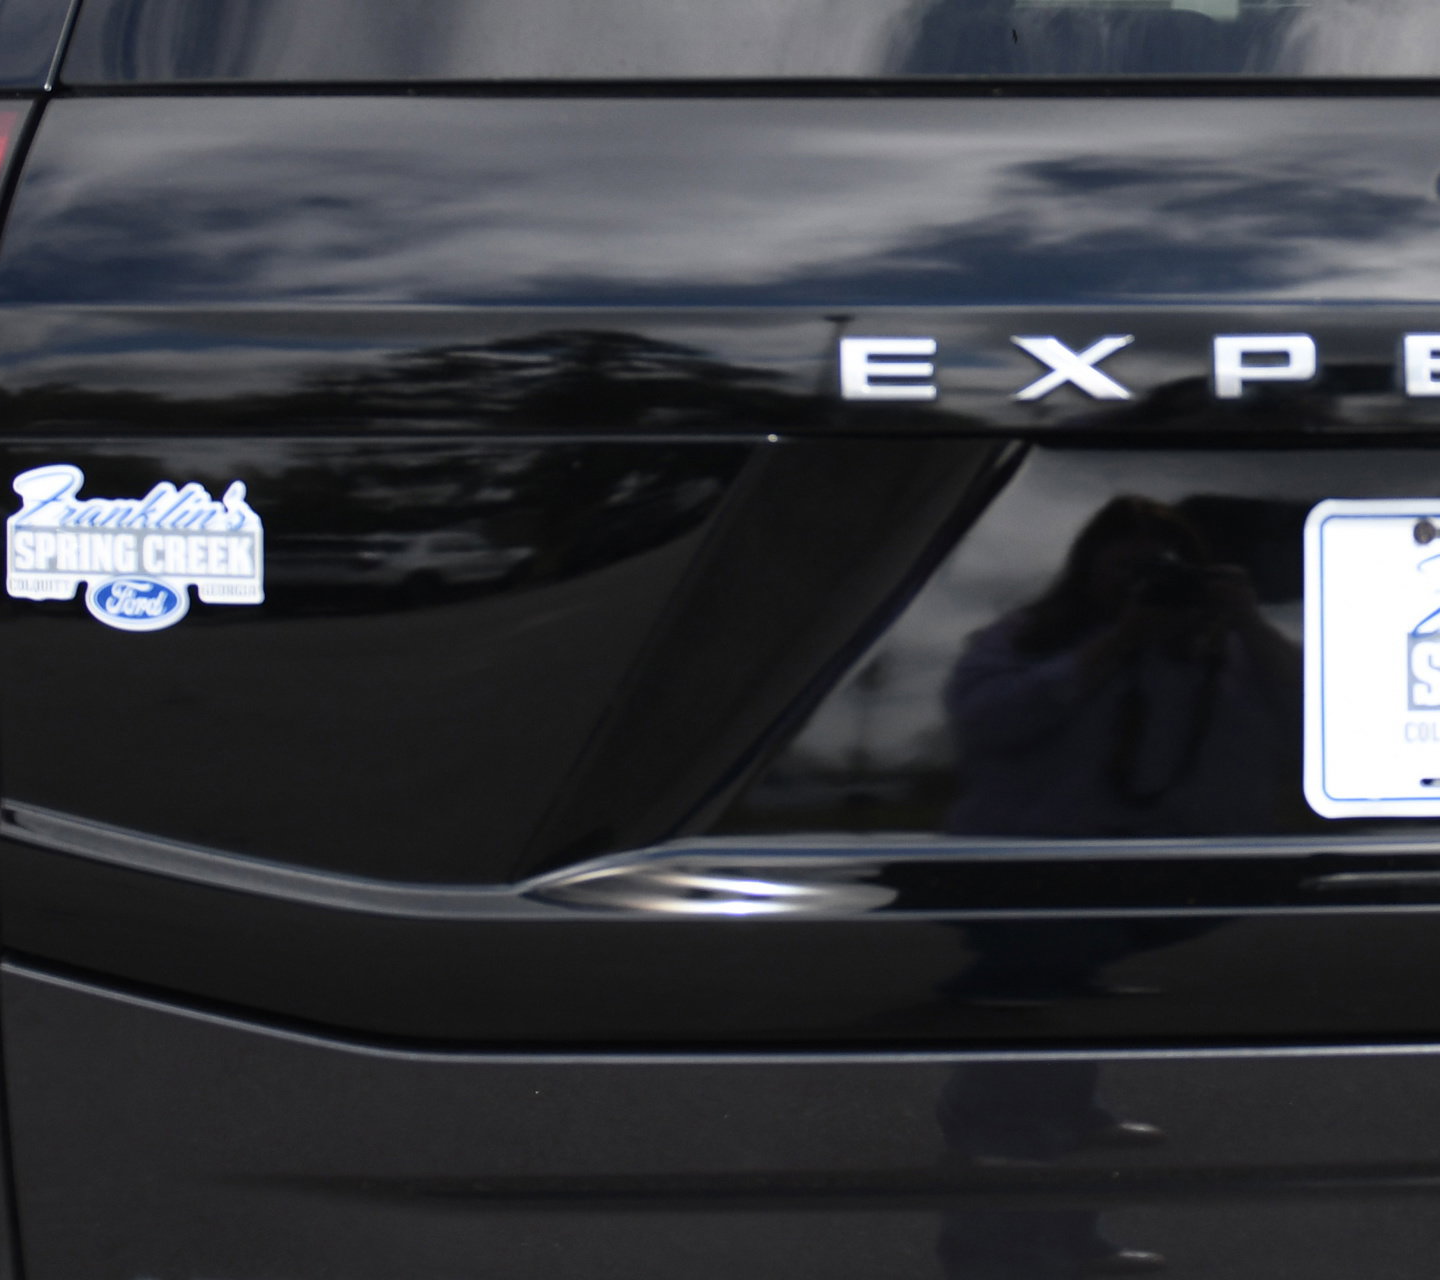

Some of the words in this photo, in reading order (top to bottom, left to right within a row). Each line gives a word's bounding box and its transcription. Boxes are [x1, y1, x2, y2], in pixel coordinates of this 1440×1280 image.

[13, 470, 248, 532] Franklin's
[14, 530, 139, 573] SPRING
[142, 532, 253, 577] CREEK
[105, 580, 168, 617] Ford
